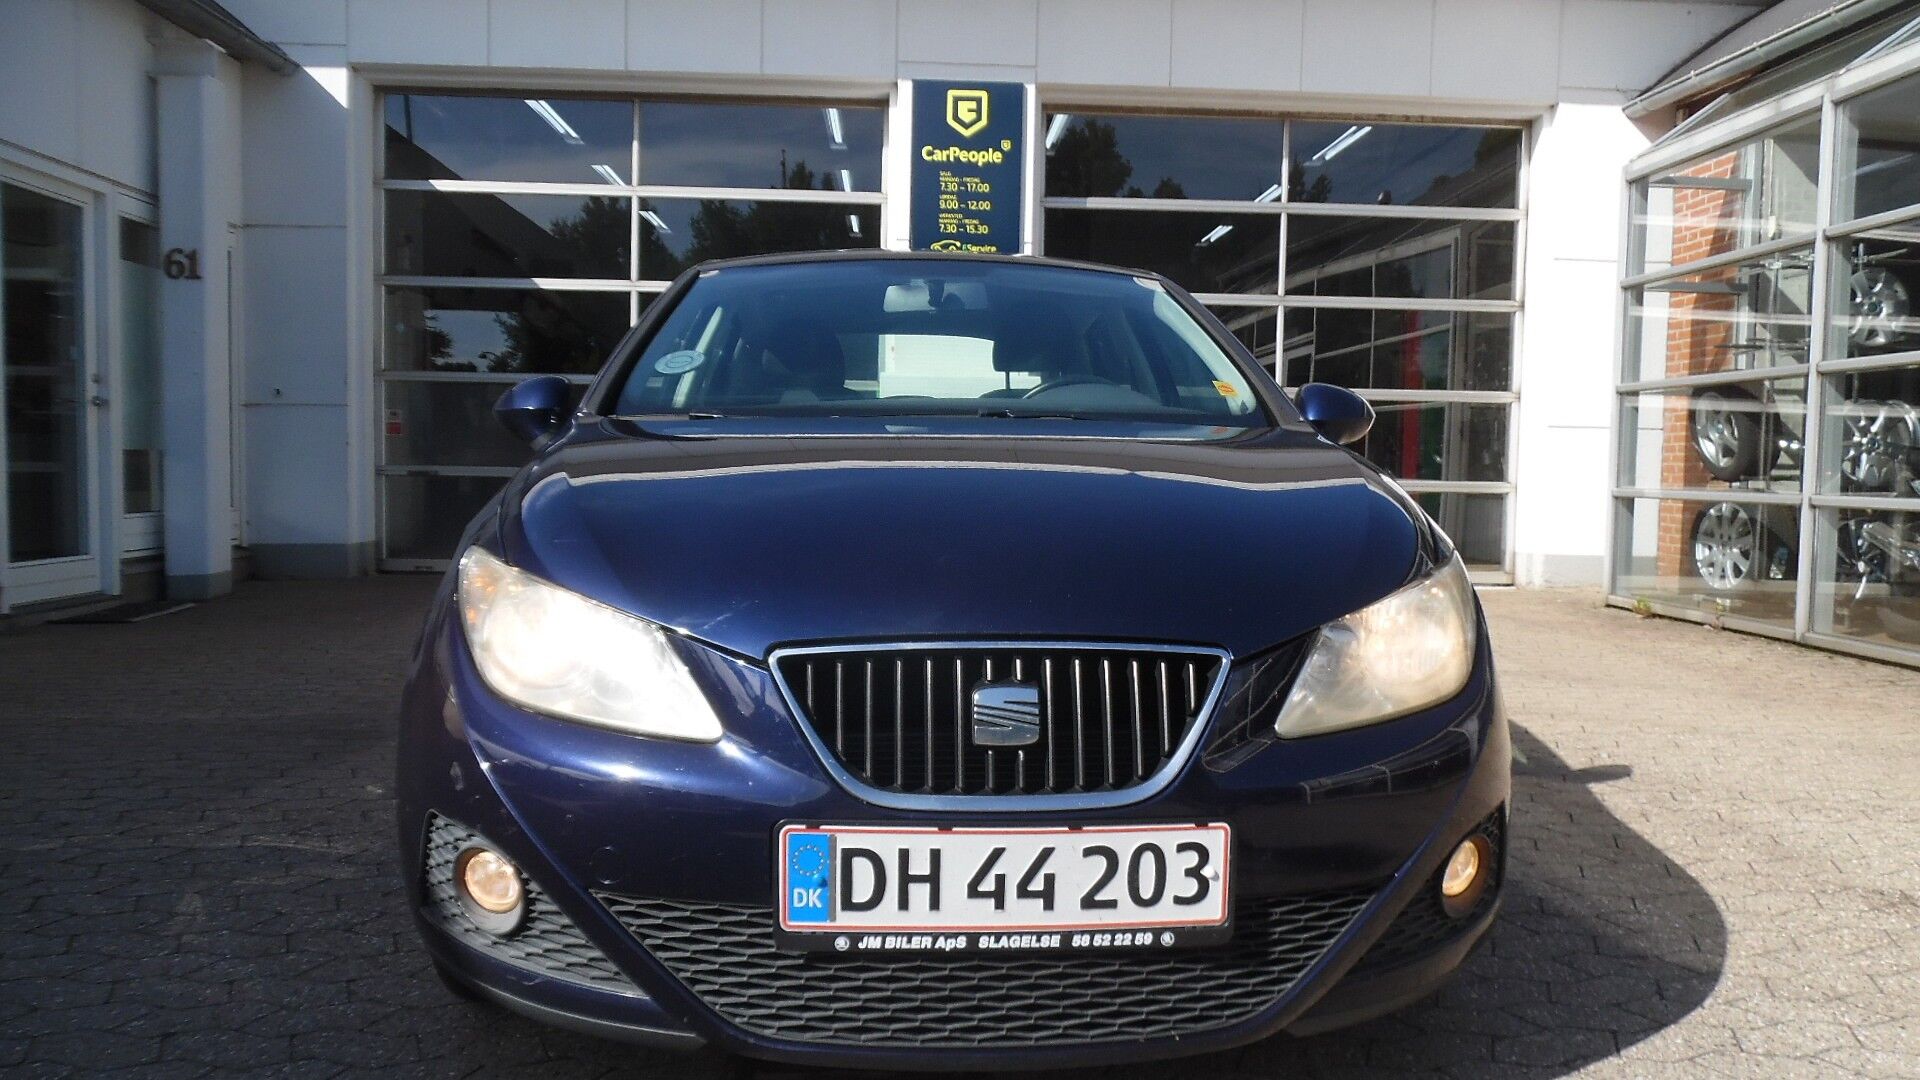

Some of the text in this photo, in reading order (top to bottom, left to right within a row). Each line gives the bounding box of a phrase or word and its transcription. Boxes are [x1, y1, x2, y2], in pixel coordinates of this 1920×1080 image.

[921, 145, 1003, 167] CarPeople
[940, 182, 958, 192] 7.30
[967, 183, 990, 193] 17.00
[939, 199, 958, 209] 9.00
[967, 200, 991, 210] 12.00
[939, 223, 957, 233] 7.30
[966, 224, 989, 234] 15.30
[163, 247, 202, 280] 61
[840, 841, 1210, 912] DH 44 203
[792, 888, 822, 908] DK
[858, 935, 882, 949] JM
[884, 935, 932, 949] BILER
[934, 935, 967, 951] ApS
[978, 935, 1061, 949] SLAGELSE
[1113, 932, 1133, 946] 22
